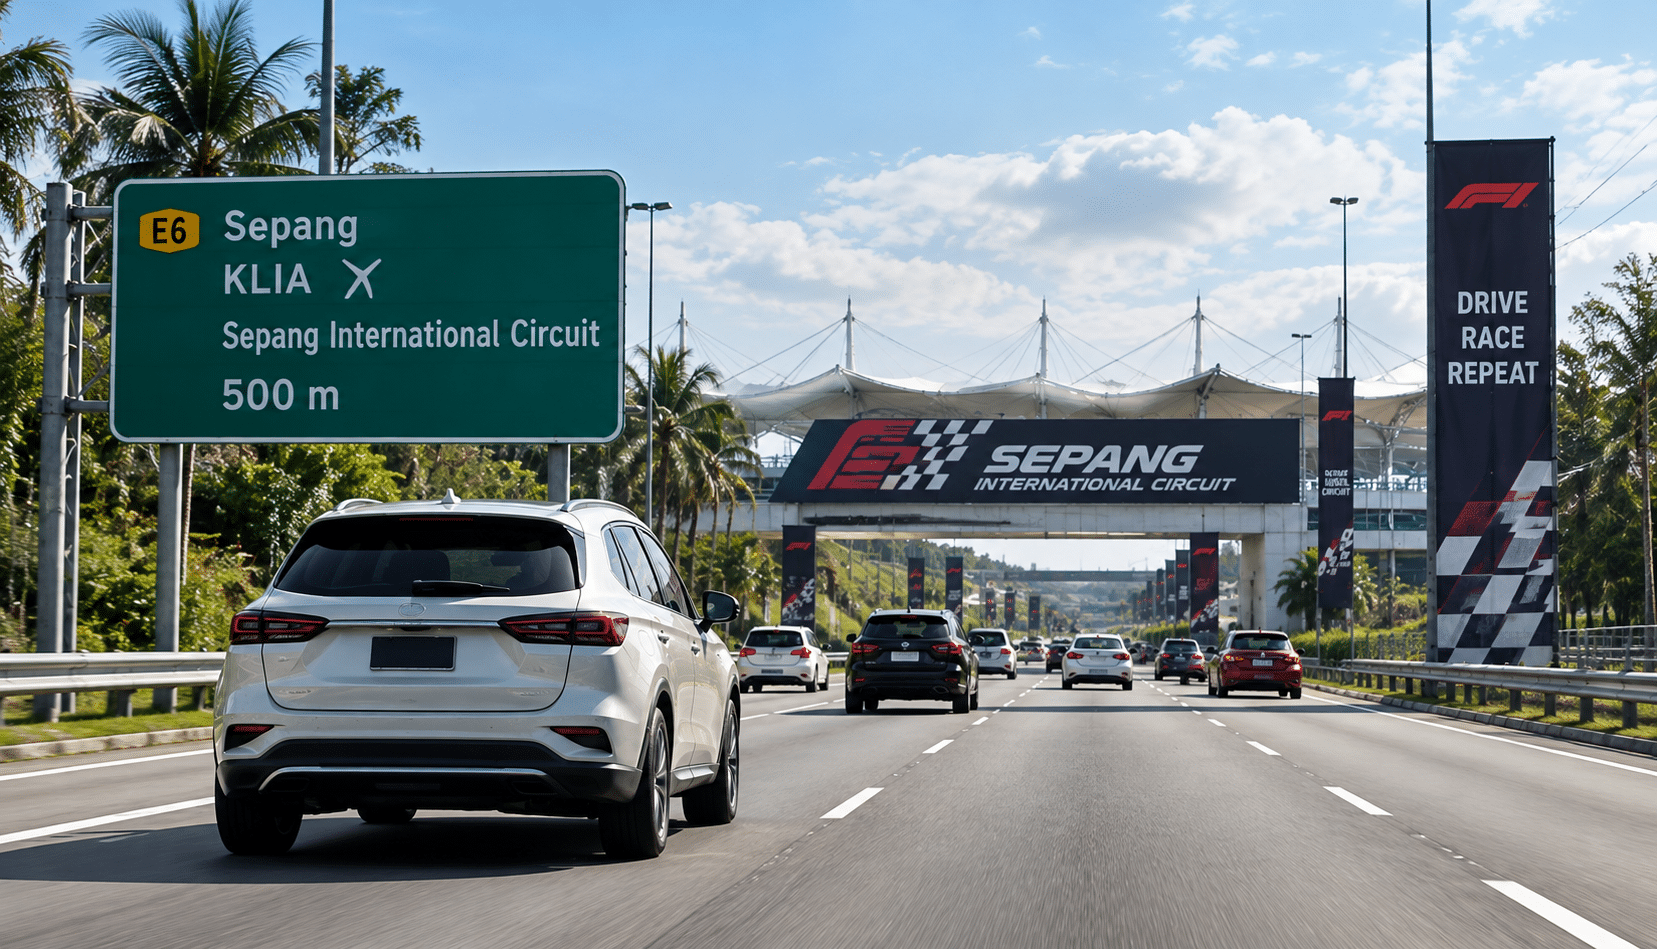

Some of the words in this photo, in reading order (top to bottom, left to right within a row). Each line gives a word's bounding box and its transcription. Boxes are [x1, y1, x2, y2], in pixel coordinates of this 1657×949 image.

[152, 216, 187, 244] E6
[224, 209, 358, 249] Sepang
[224, 263, 312, 295] KLIA
[1457, 290, 1528, 315] DRIVE
[222, 320, 319, 356] Sepang
[330, 318, 500, 349] International
[511, 317, 601, 349] Circuit
[1461, 325, 1525, 350] RACE
[1447, 360, 1539, 386] REPEAT
[222, 378, 294, 412] 500
[308, 386, 340, 411] m
[983, 444, 1204, 474] SEPANG
[974, 478, 1144, 491] INTERNATIONAL
[1151, 478, 1236, 491] CIRCUIT
